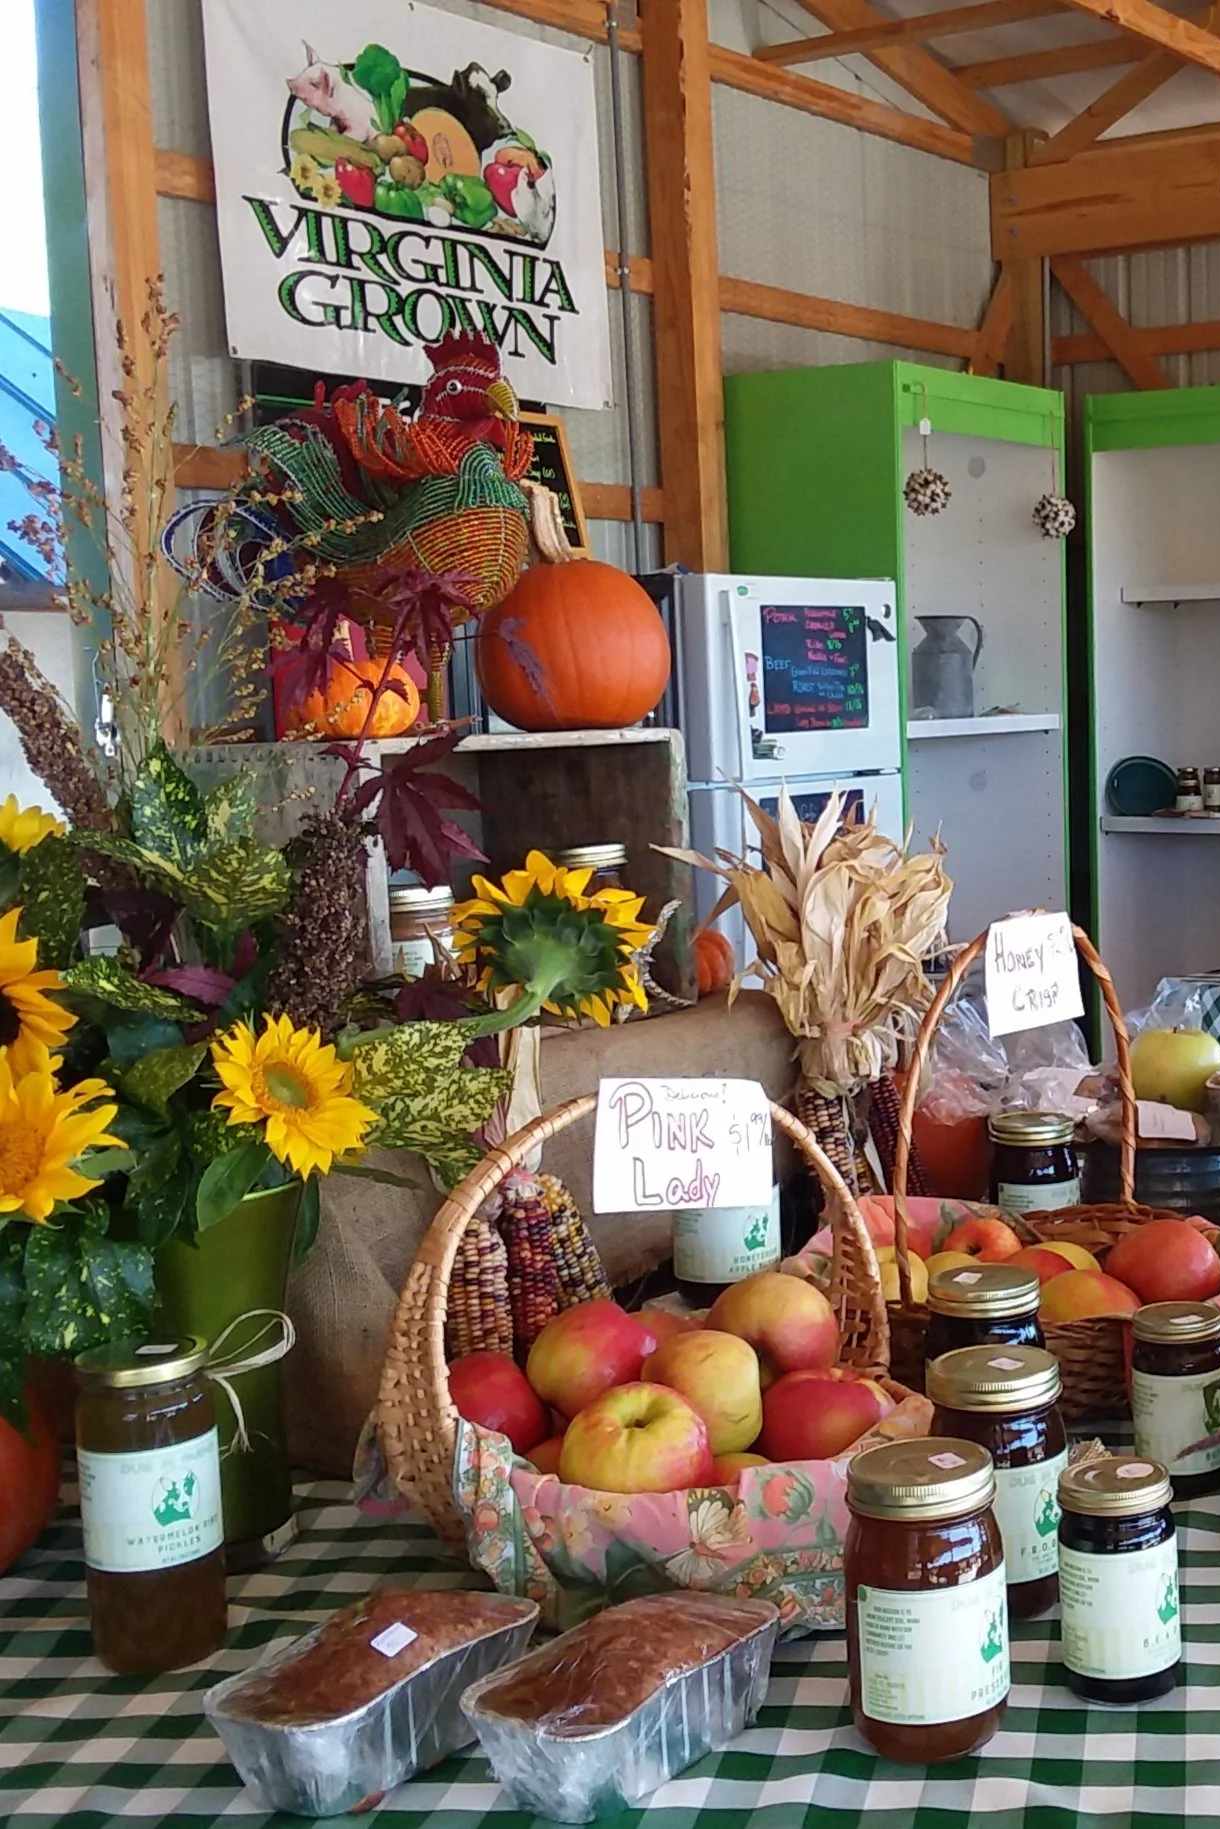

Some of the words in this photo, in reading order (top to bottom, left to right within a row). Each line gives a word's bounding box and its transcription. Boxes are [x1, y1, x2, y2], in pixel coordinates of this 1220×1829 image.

[242, 195, 579, 314] VIRGINIA
[278, 269, 563, 364] GROWN
[764, 655, 792, 670] BEEF
[994, 931, 1044, 975] HONEY
[632, 1156, 721, 1208] Lady
[728, 1263, 756, 1274] APPLE
[157, 1536, 202, 1554] PICKLES
